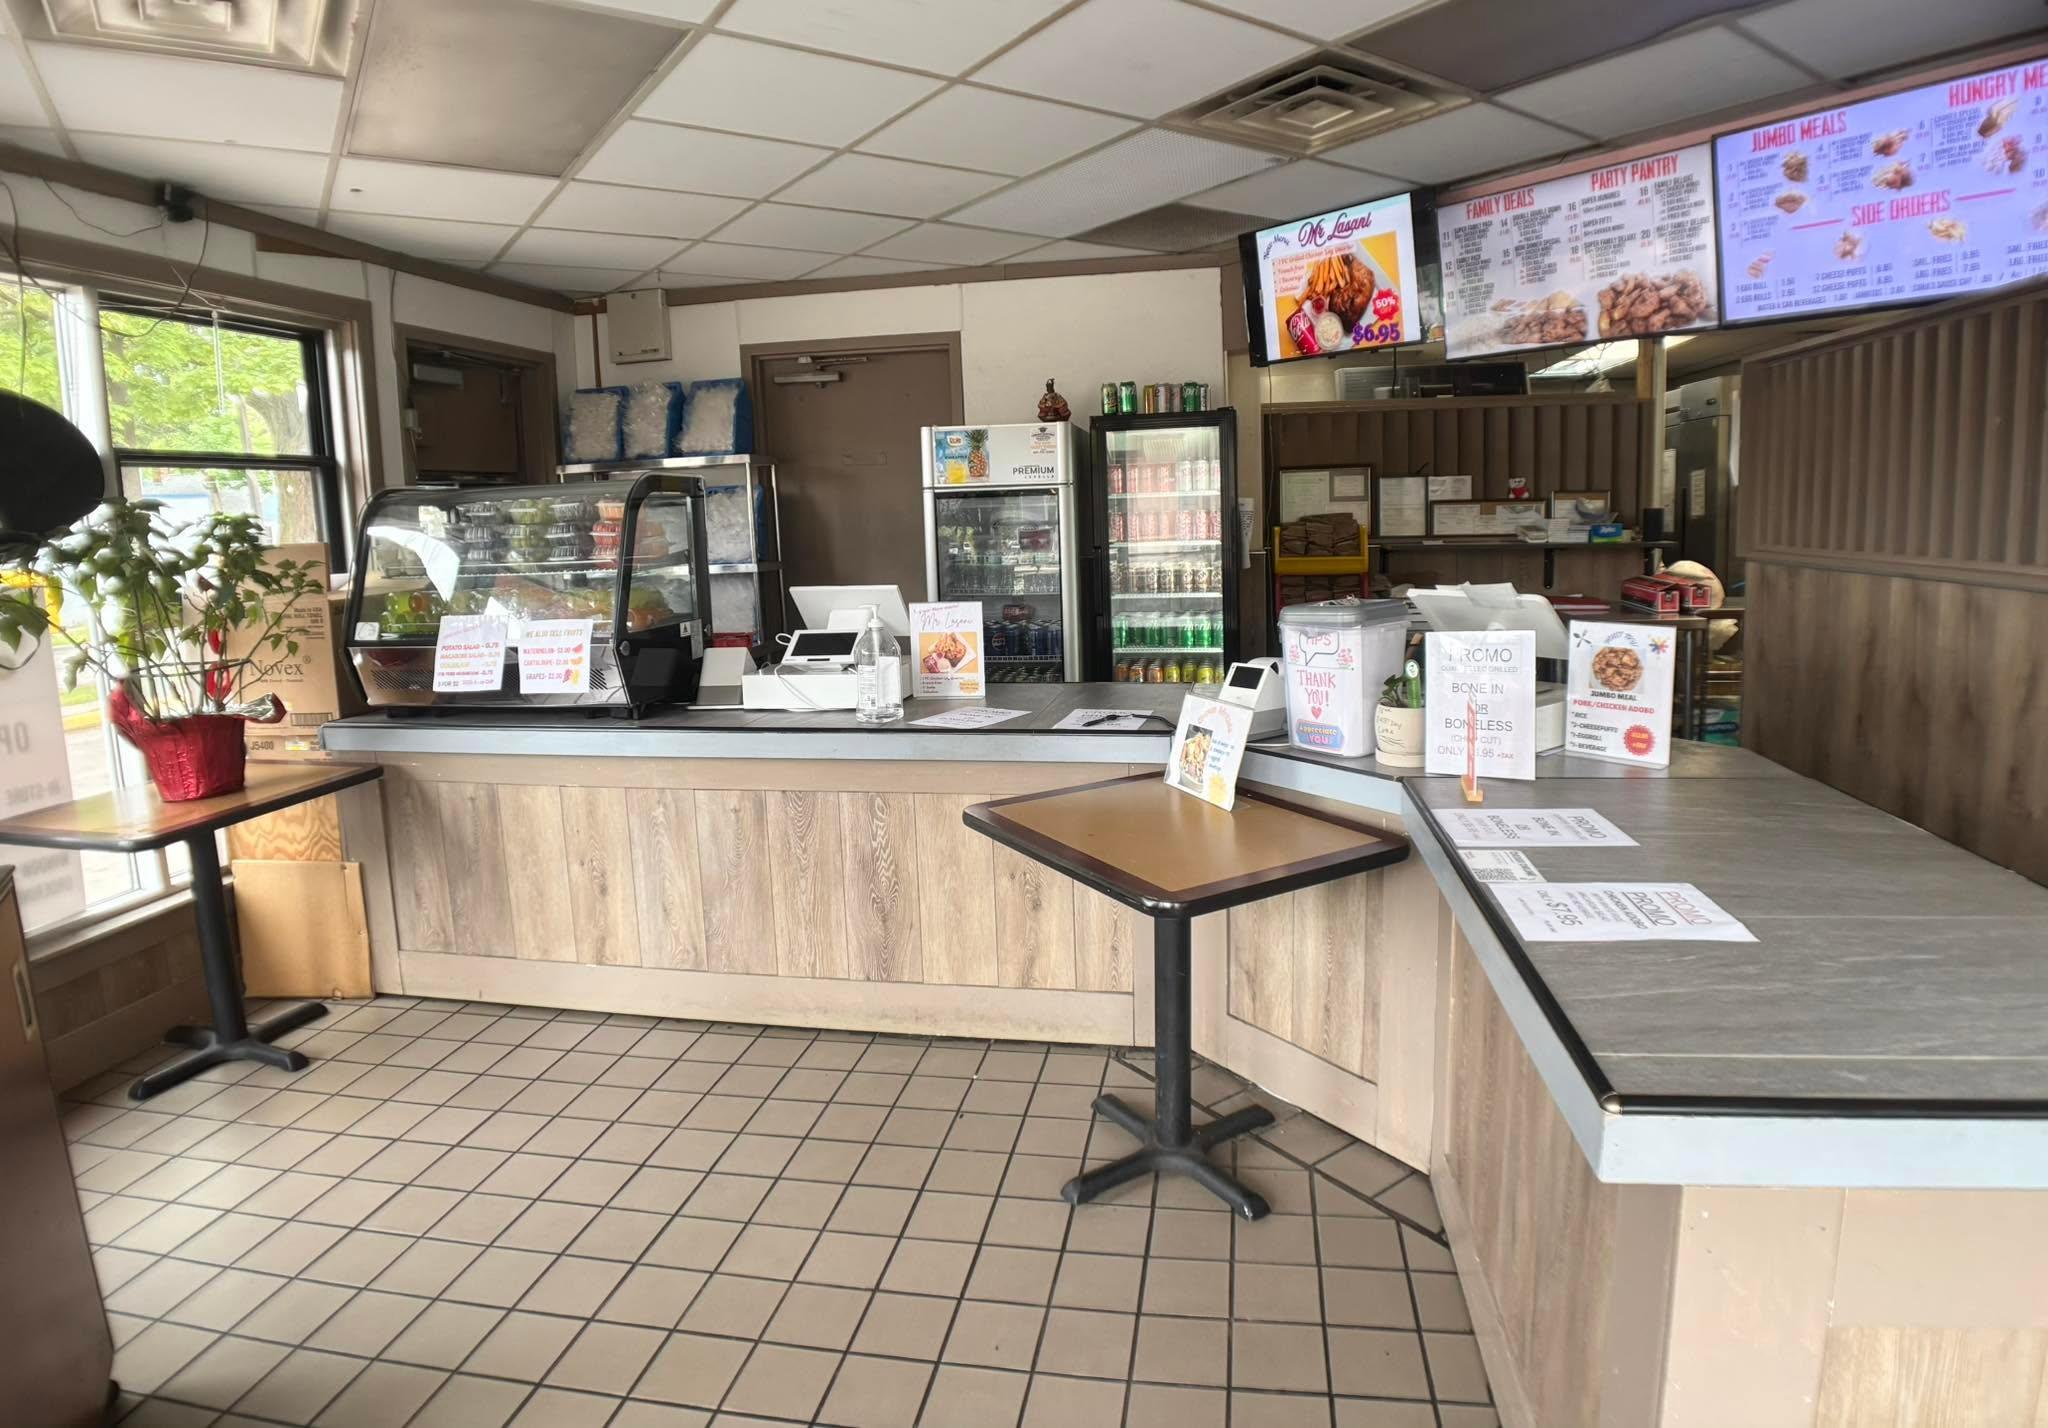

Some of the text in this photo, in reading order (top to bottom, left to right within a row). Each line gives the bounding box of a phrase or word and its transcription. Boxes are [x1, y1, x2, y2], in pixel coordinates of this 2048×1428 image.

[1949, 70, 2017, 107] HUNGRY
[1752, 112, 1846, 153] JUMBO MEALS
[1591, 155, 1678, 191] PARTY PANTRY
[1466, 189, 1535, 220] FAMILY DEALS
[1852, 190, 1951, 227] SIDE ORDERS
[1374, 296, 1397, 309] 50%
[1352, 324, 1401, 345] $6.95
[1012, 467, 1055, 475] PREMIUM
[1296, 669, 1336, 688] THANK
[1452, 683, 1504, 694] BONE IN
[1305, 689, 1329, 707] YOU!
[1591, 690, 1638, 701] JUMBO MEAL
[1628, 706, 1656, 714] ADOBO
[1566, 814, 1606, 839] PROMO
[1544, 902, 1584, 925] $7.95
[1623, 891, 1677, 927] PROMO
[1656, 891, 1713, 926] PROMO
